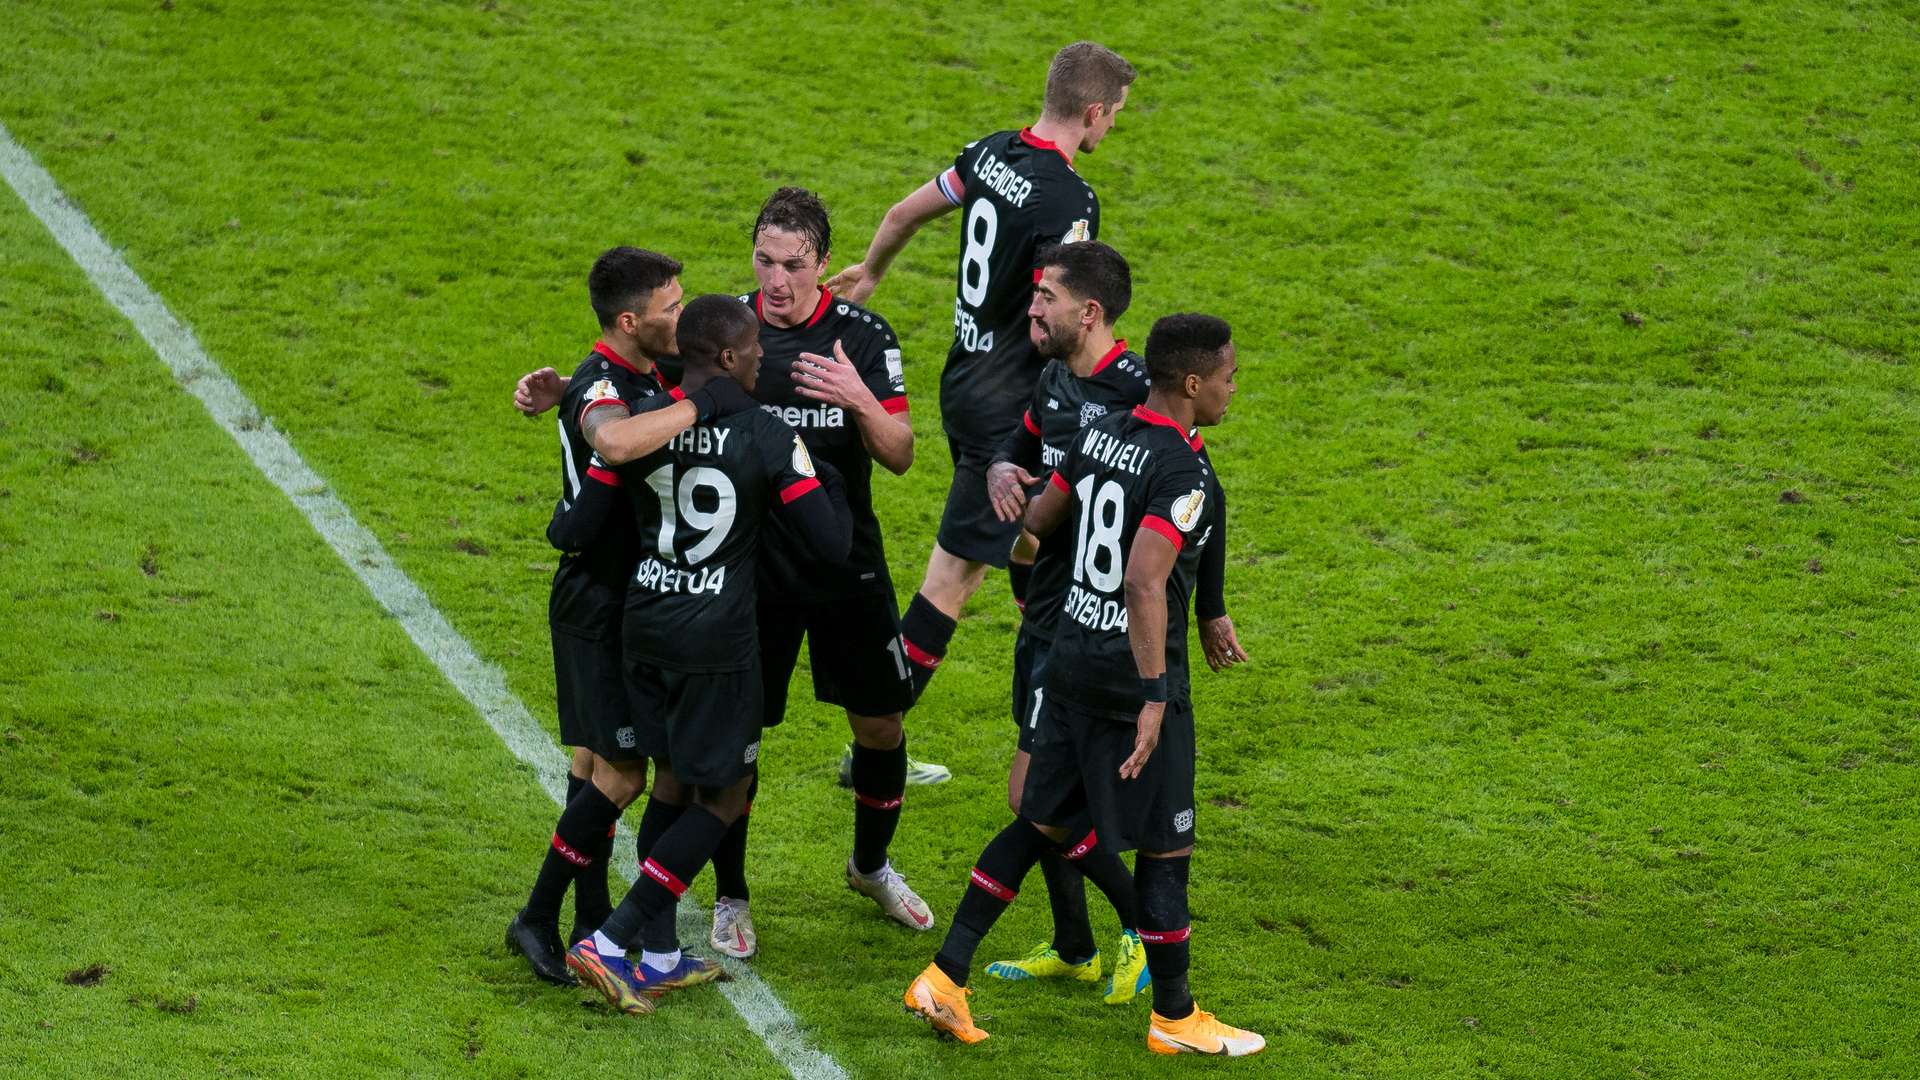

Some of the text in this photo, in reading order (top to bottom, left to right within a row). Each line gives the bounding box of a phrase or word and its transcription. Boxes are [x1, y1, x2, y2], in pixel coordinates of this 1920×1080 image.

[962, 198, 998, 308] 8
[645, 463, 737, 566] 19
[1074, 474, 1125, 593] 18
[887, 632, 911, 681] 1
